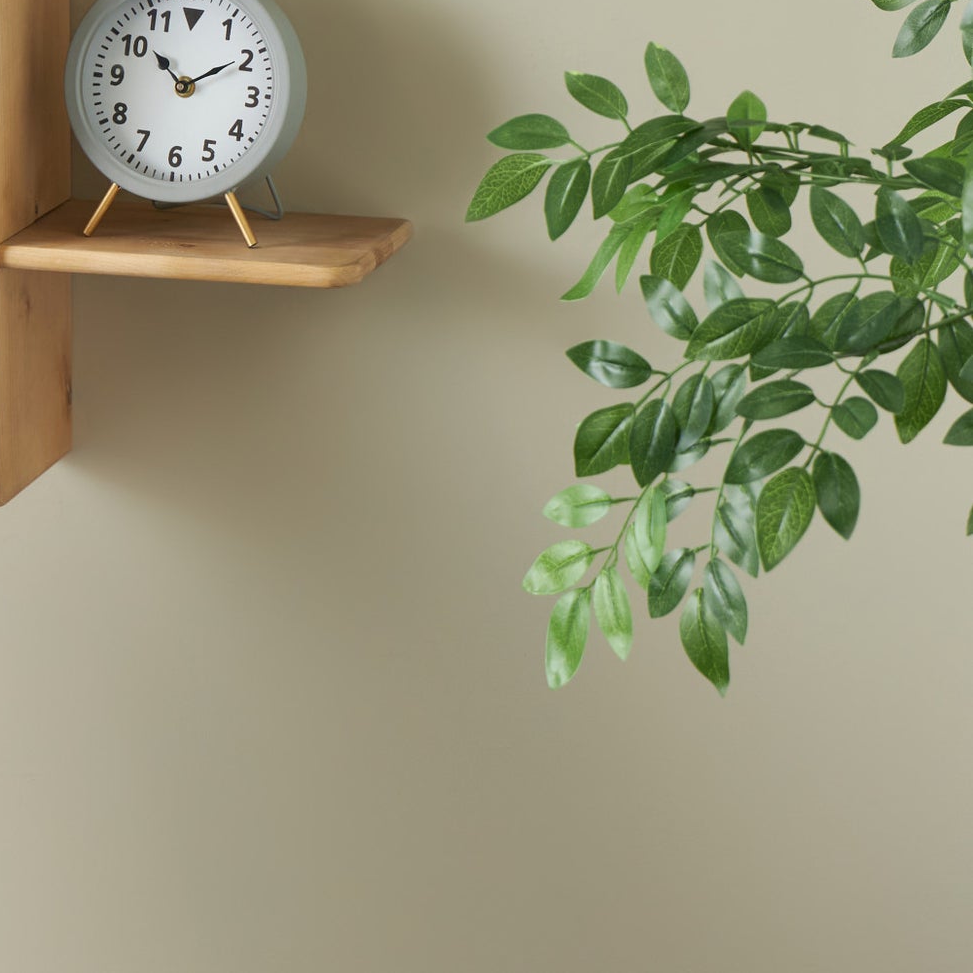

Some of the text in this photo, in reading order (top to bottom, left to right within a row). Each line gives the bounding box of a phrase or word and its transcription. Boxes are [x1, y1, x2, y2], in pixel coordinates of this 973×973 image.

[147, 9, 171, 32] 11
[222, 19, 232, 40] 1
[121, 34, 148, 57] 10
[239, 49, 253, 72] 2
[110, 64, 125, 86] 9
[245, 86, 259, 108] 3
[112, 102, 128, 125] 8
[137, 129, 150, 152] 7
[229, 119, 244, 141] 4
[168, 146, 182, 167] 6
[202, 139, 216, 162] 5
